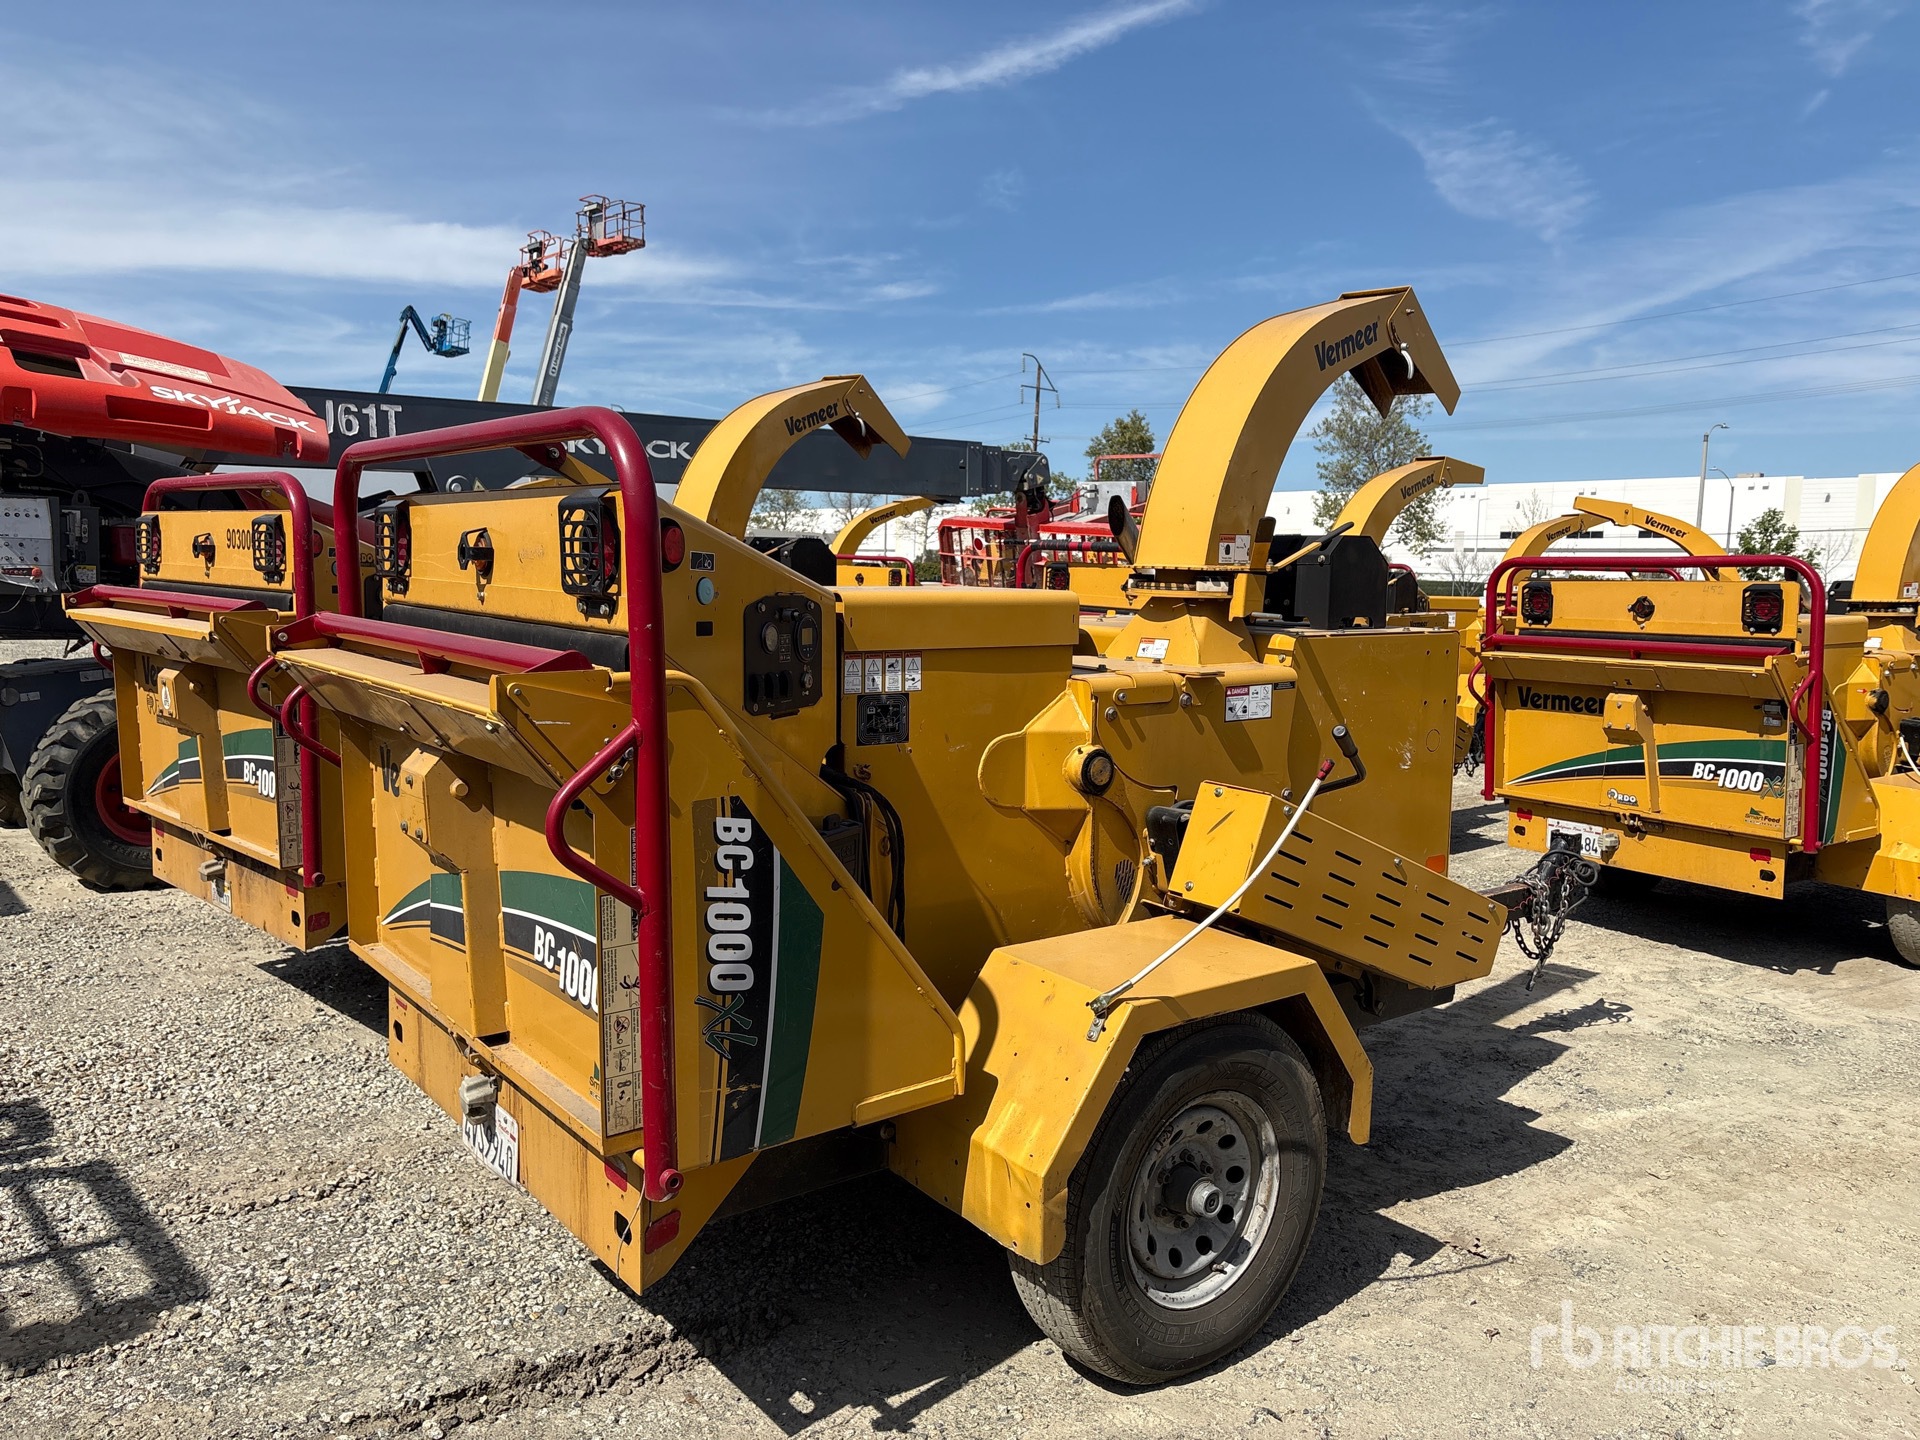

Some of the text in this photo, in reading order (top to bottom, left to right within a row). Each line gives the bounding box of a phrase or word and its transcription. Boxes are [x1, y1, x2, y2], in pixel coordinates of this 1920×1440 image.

[1313, 321, 1379, 372] Vermeer
[150, 385, 317, 434] SKYJACK
[783, 401, 839, 437] Vermeer
[1400, 473, 1435, 500] Vermeer
[868, 509, 897, 525] Vermeer
[1644, 514, 1688, 539] Vermeer
[226, 528, 253, 550] 90300
[1545, 525, 1572, 542] Vermeer
